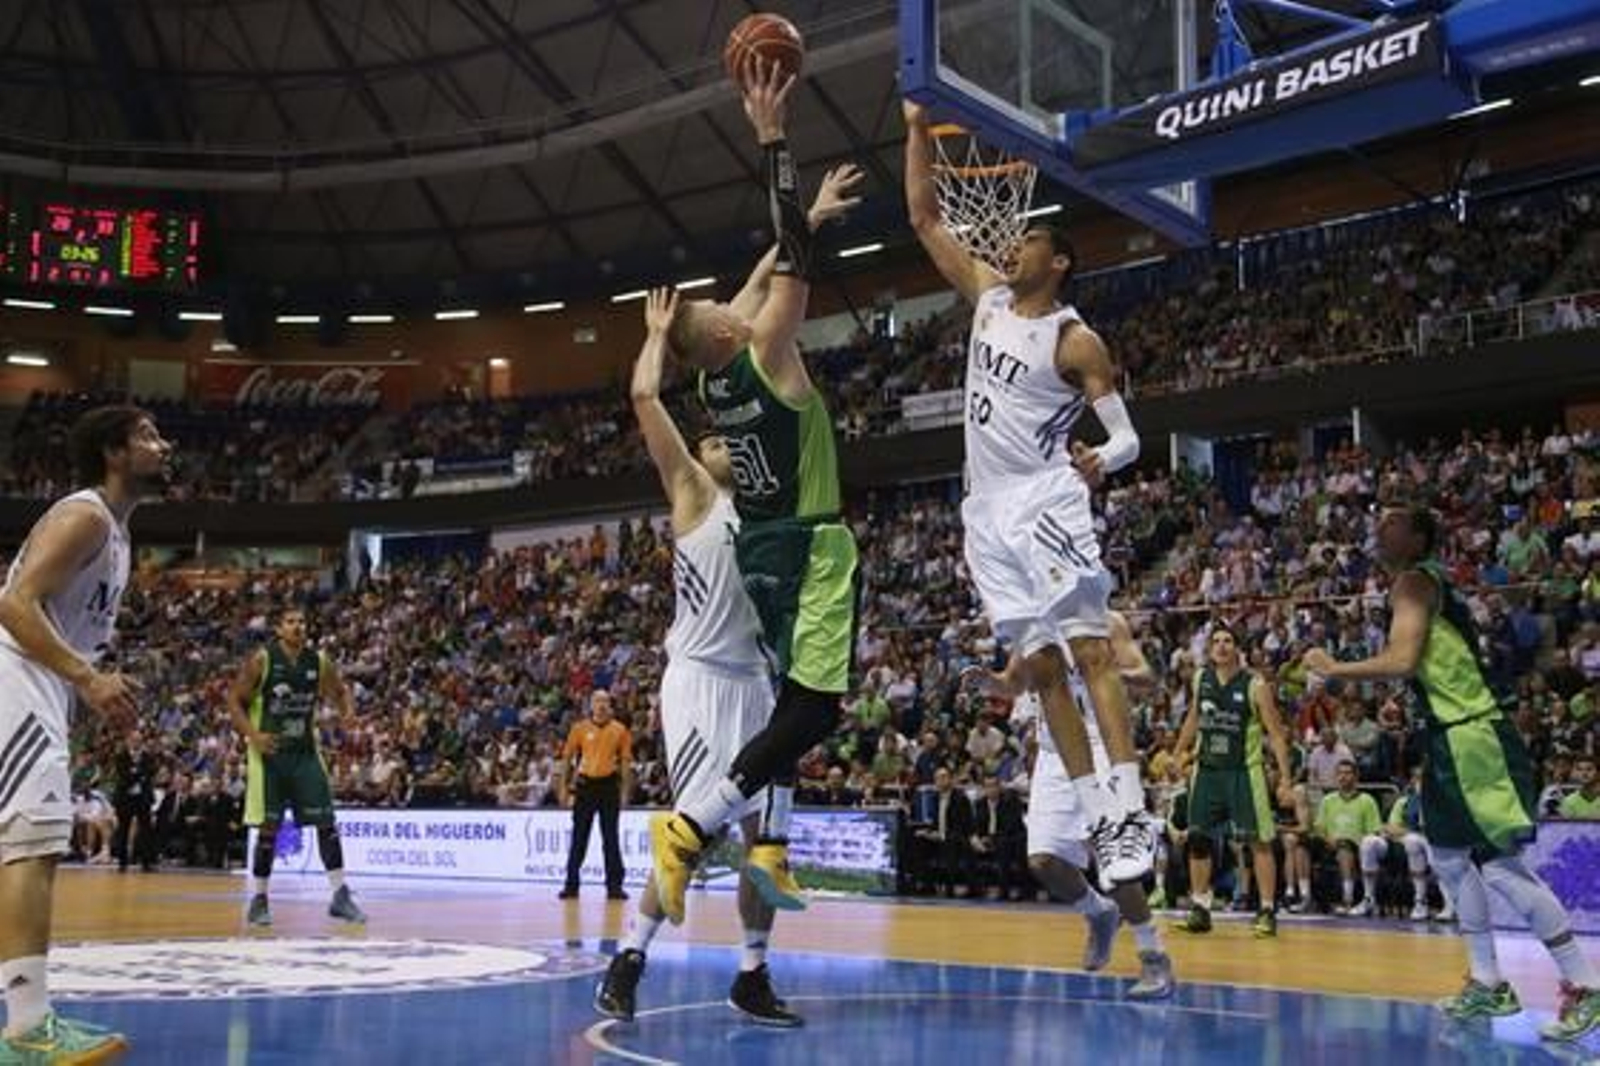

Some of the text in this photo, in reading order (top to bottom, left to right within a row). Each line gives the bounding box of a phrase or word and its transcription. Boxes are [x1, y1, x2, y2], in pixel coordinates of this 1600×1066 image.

[1155, 80, 1266, 138] QUINI
[1275, 21, 1431, 100] BASKET
[337, 821, 390, 838] ESERVA
